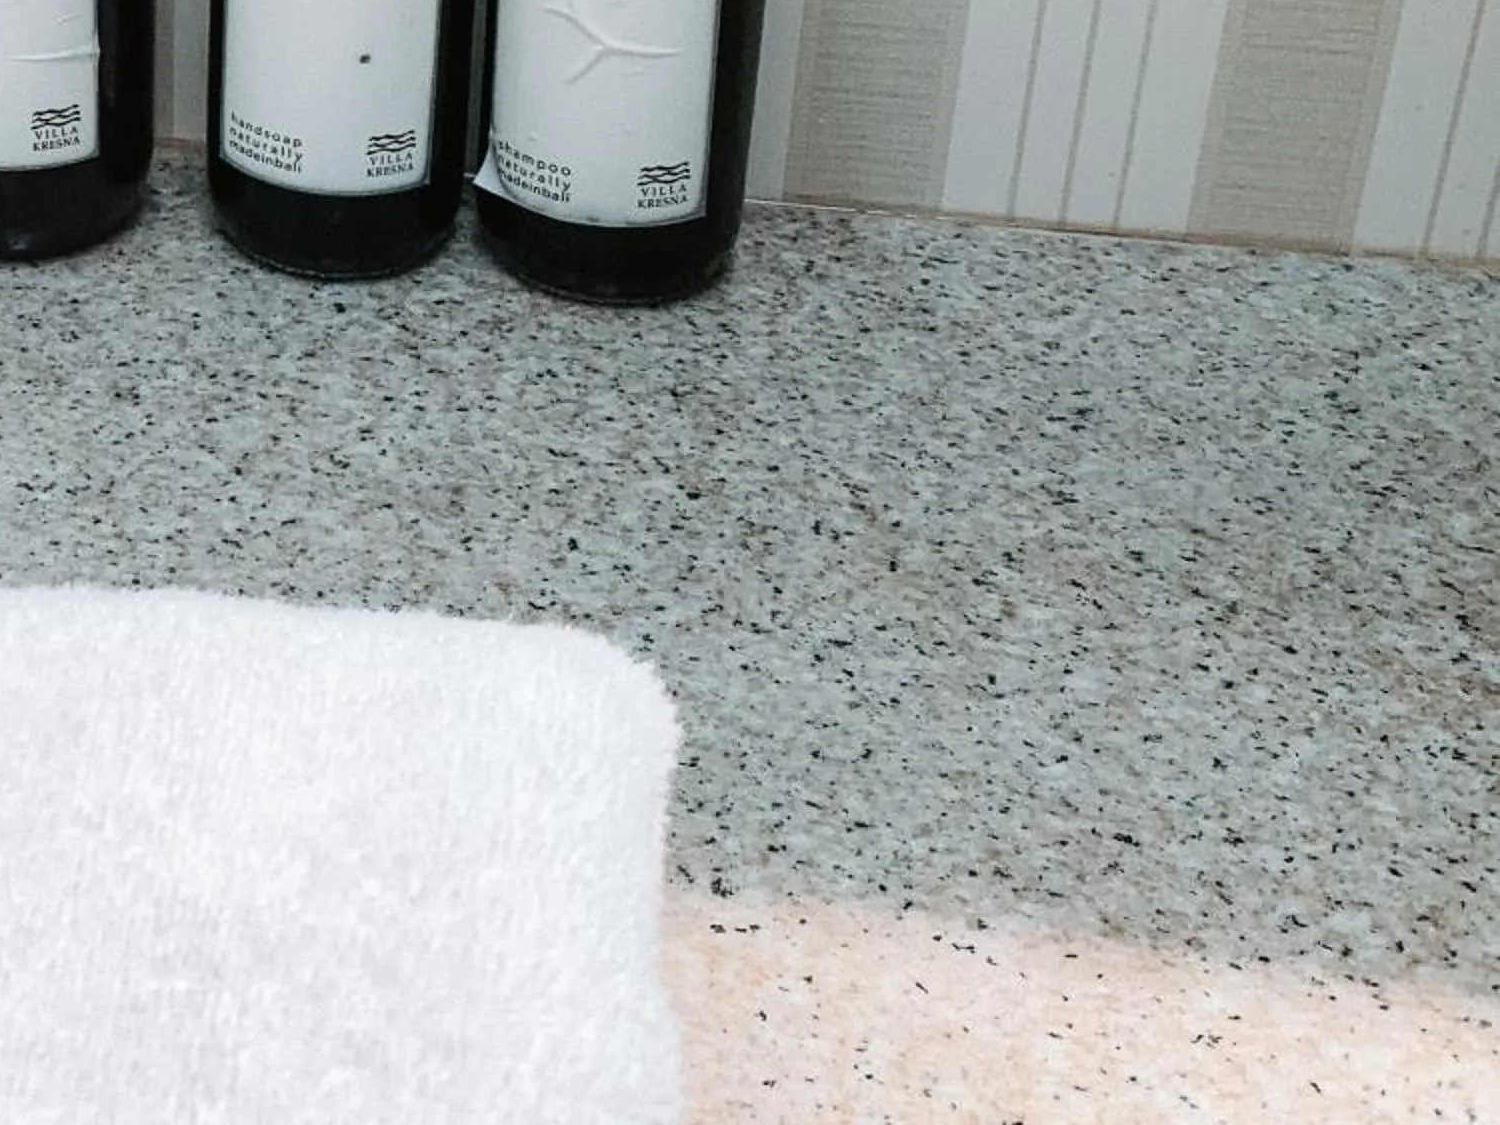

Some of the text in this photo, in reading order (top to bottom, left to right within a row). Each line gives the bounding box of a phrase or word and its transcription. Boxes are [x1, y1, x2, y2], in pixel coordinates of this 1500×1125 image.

[34, 126, 78, 140] VILLA
[231, 110, 302, 148] handsoap
[32, 136, 81, 152] KRESNA
[229, 127, 303, 164] naturally
[369, 151, 413, 166] VILLA
[499, 140, 571, 176] shampoo
[498, 154, 571, 192] naturally
[641, 183, 687, 197] VILLA
